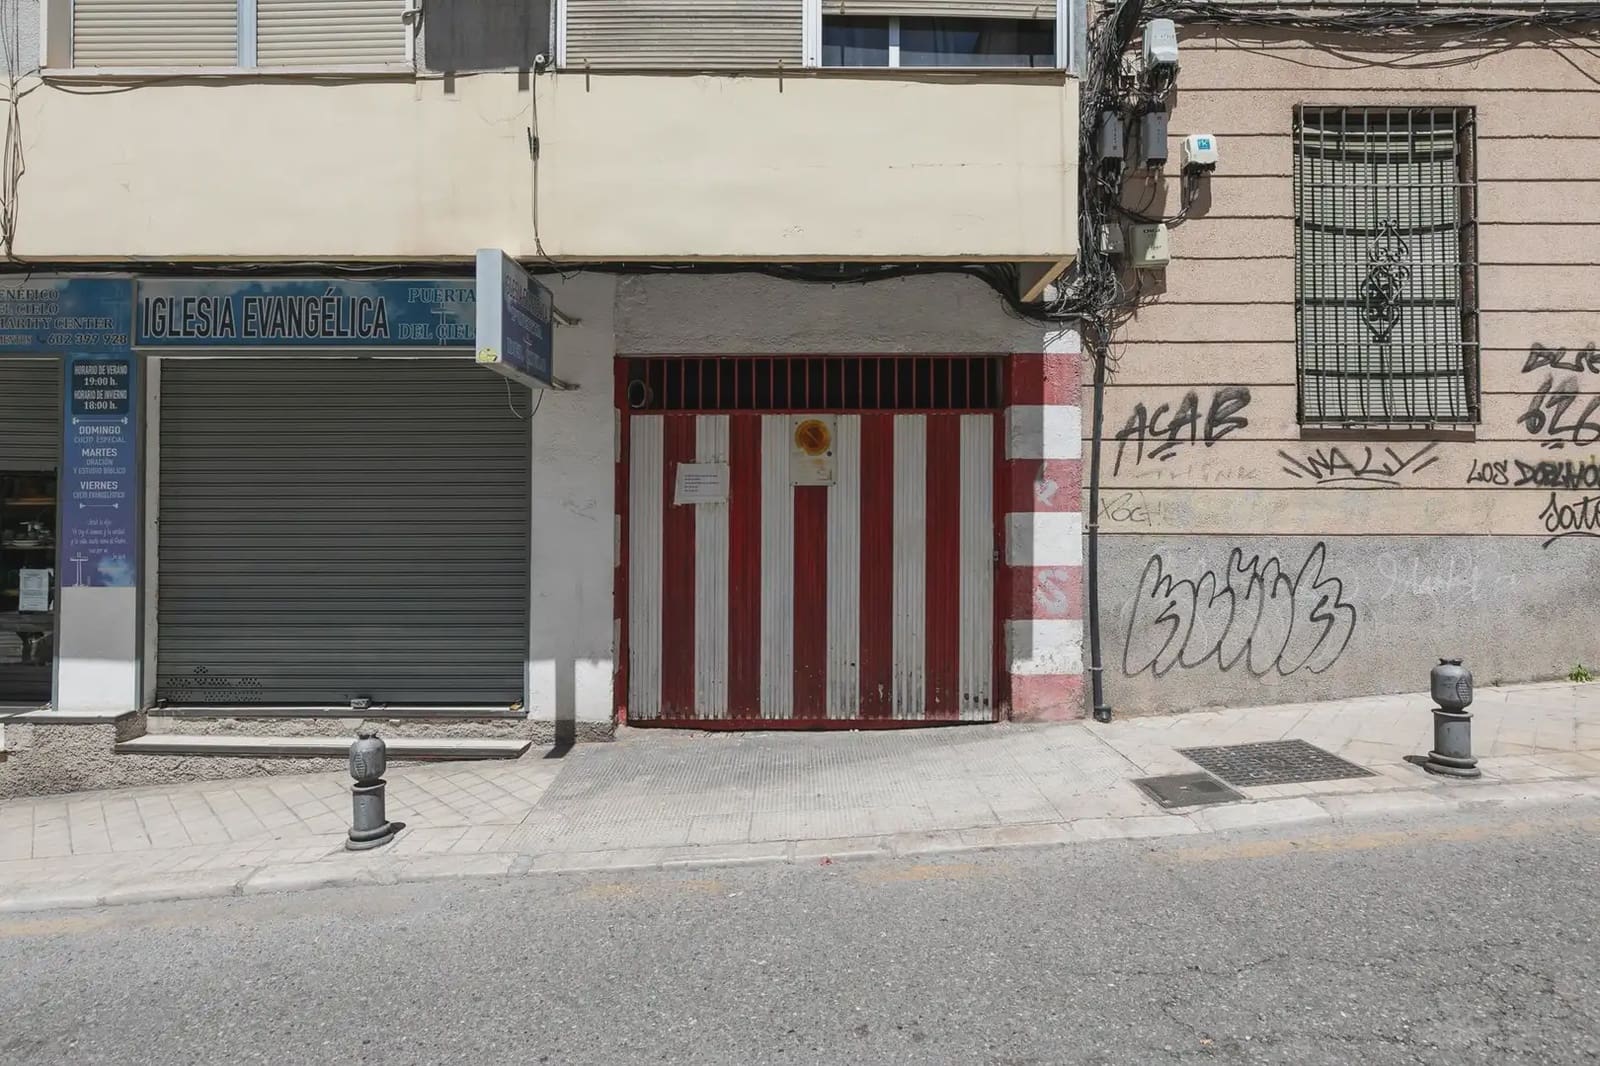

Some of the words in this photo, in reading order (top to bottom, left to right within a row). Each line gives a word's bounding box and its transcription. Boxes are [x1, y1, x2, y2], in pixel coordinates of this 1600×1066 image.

[408, 288, 476, 303] PUERTA
[16, 303, 59, 315] CIELO
[142, 296, 236, 339] IGLESIA
[242, 287, 390, 339] EVANGÉLICA
[54, 317, 113, 330] CENTER
[398, 323, 433, 340] DEL
[435, 323, 476, 340] CIEL
[102, 333, 128, 346] 928
[98, 365, 106, 375] DE
[84, 377, 108, 386] 19:00
[109, 377, 118, 386] h.
[96, 389, 104, 400] DE
[84, 400, 108, 410] 18:00
[109, 400, 118, 410] h.
[79, 425, 121, 435] DOMINGO
[1113, 386, 1252, 477] ACAB
[81, 447, 118, 457] MARTES
[1467, 458, 1510, 486] LOS
[80, 480, 119, 490] VIERNES
